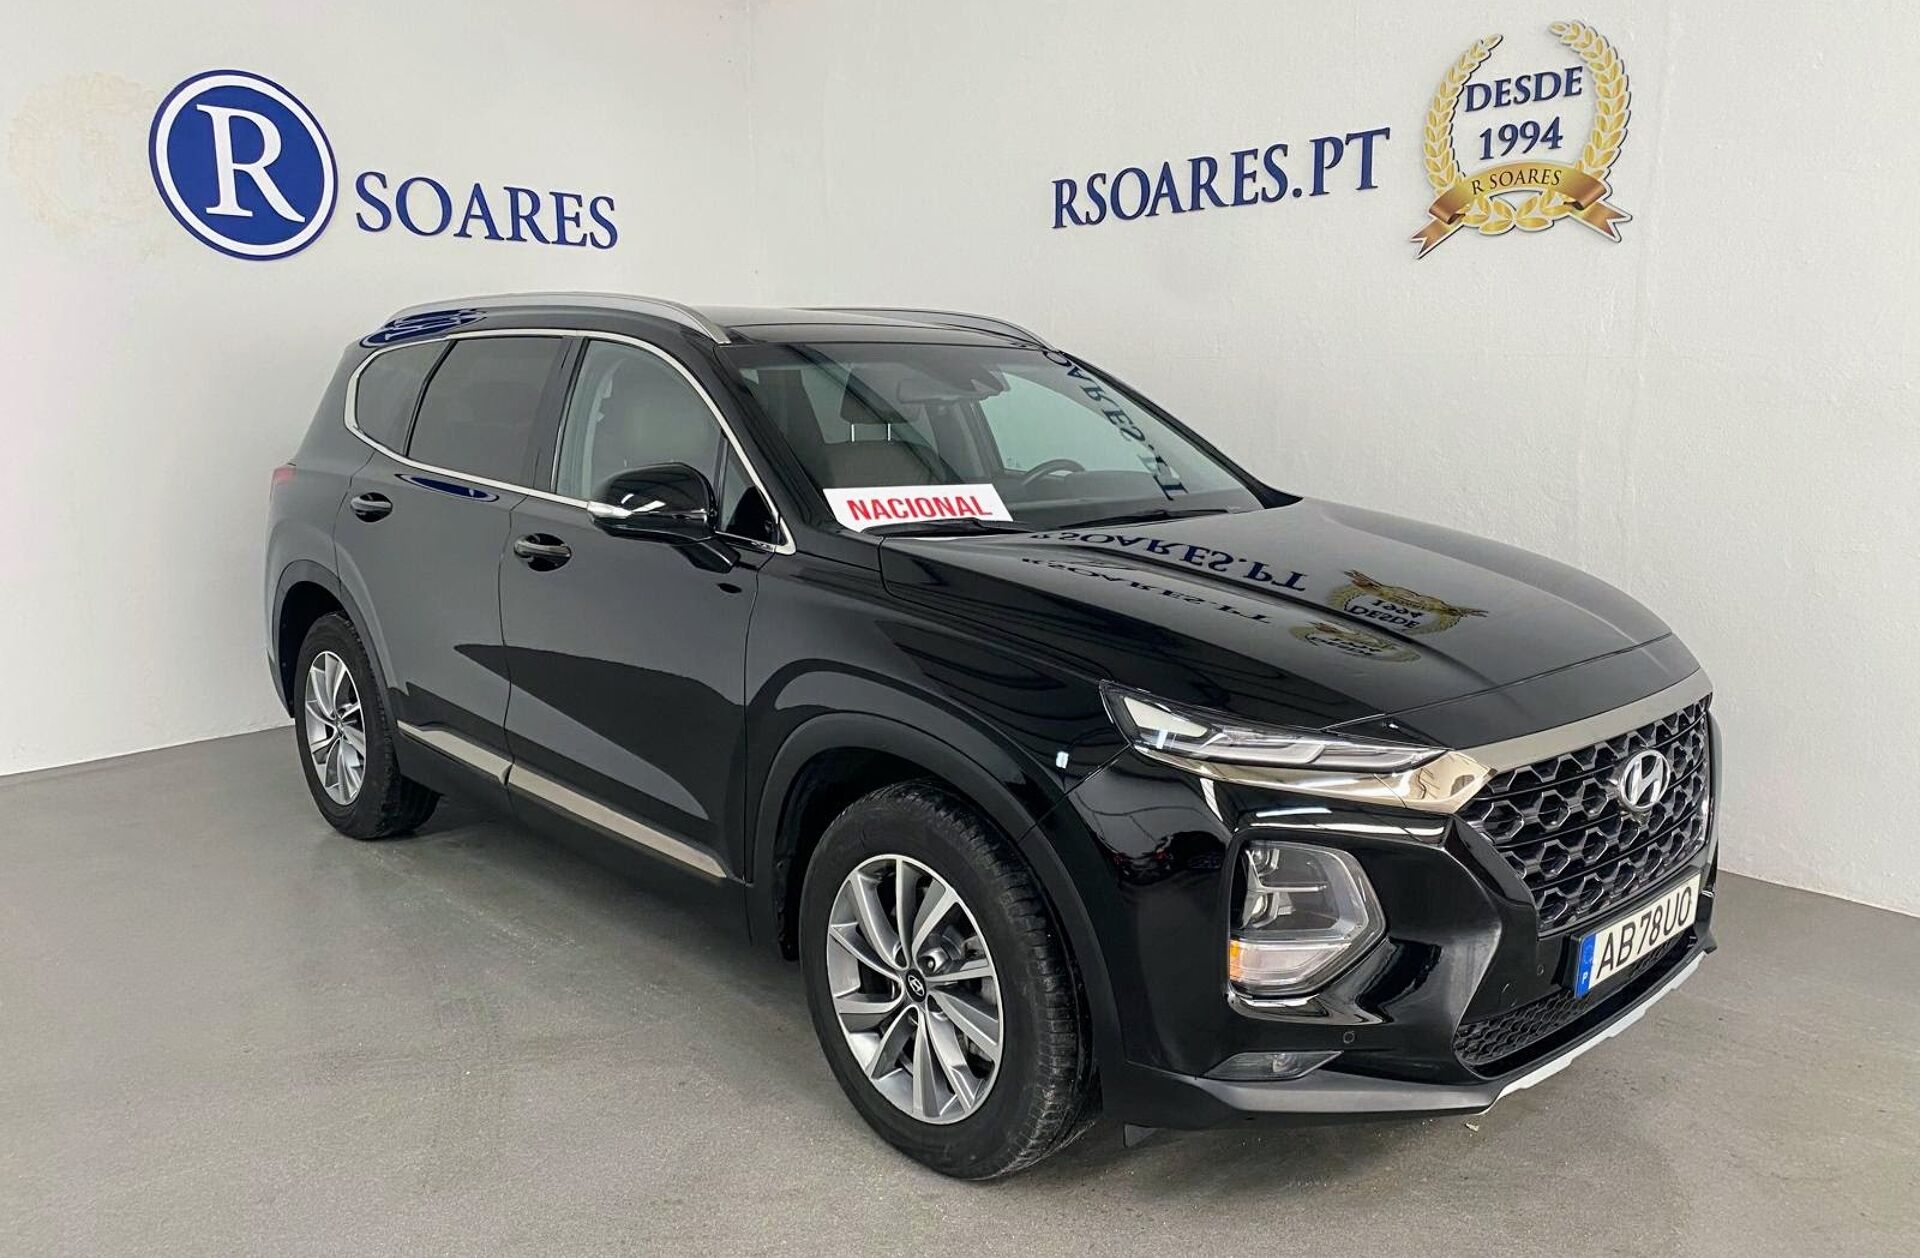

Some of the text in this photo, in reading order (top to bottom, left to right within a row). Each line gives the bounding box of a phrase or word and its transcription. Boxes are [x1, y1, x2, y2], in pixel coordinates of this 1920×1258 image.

[1464, 65, 1584, 114] DESDE
[1478, 116, 1564, 161] 1994
[196, 103, 619, 250] R SOARES
[1051, 126, 1391, 230] RSOARES.PT
[1471, 168, 1563, 197] R SOARES
[846, 495, 993, 522] NACIONAL
[1582, 969, 1589, 984] P
